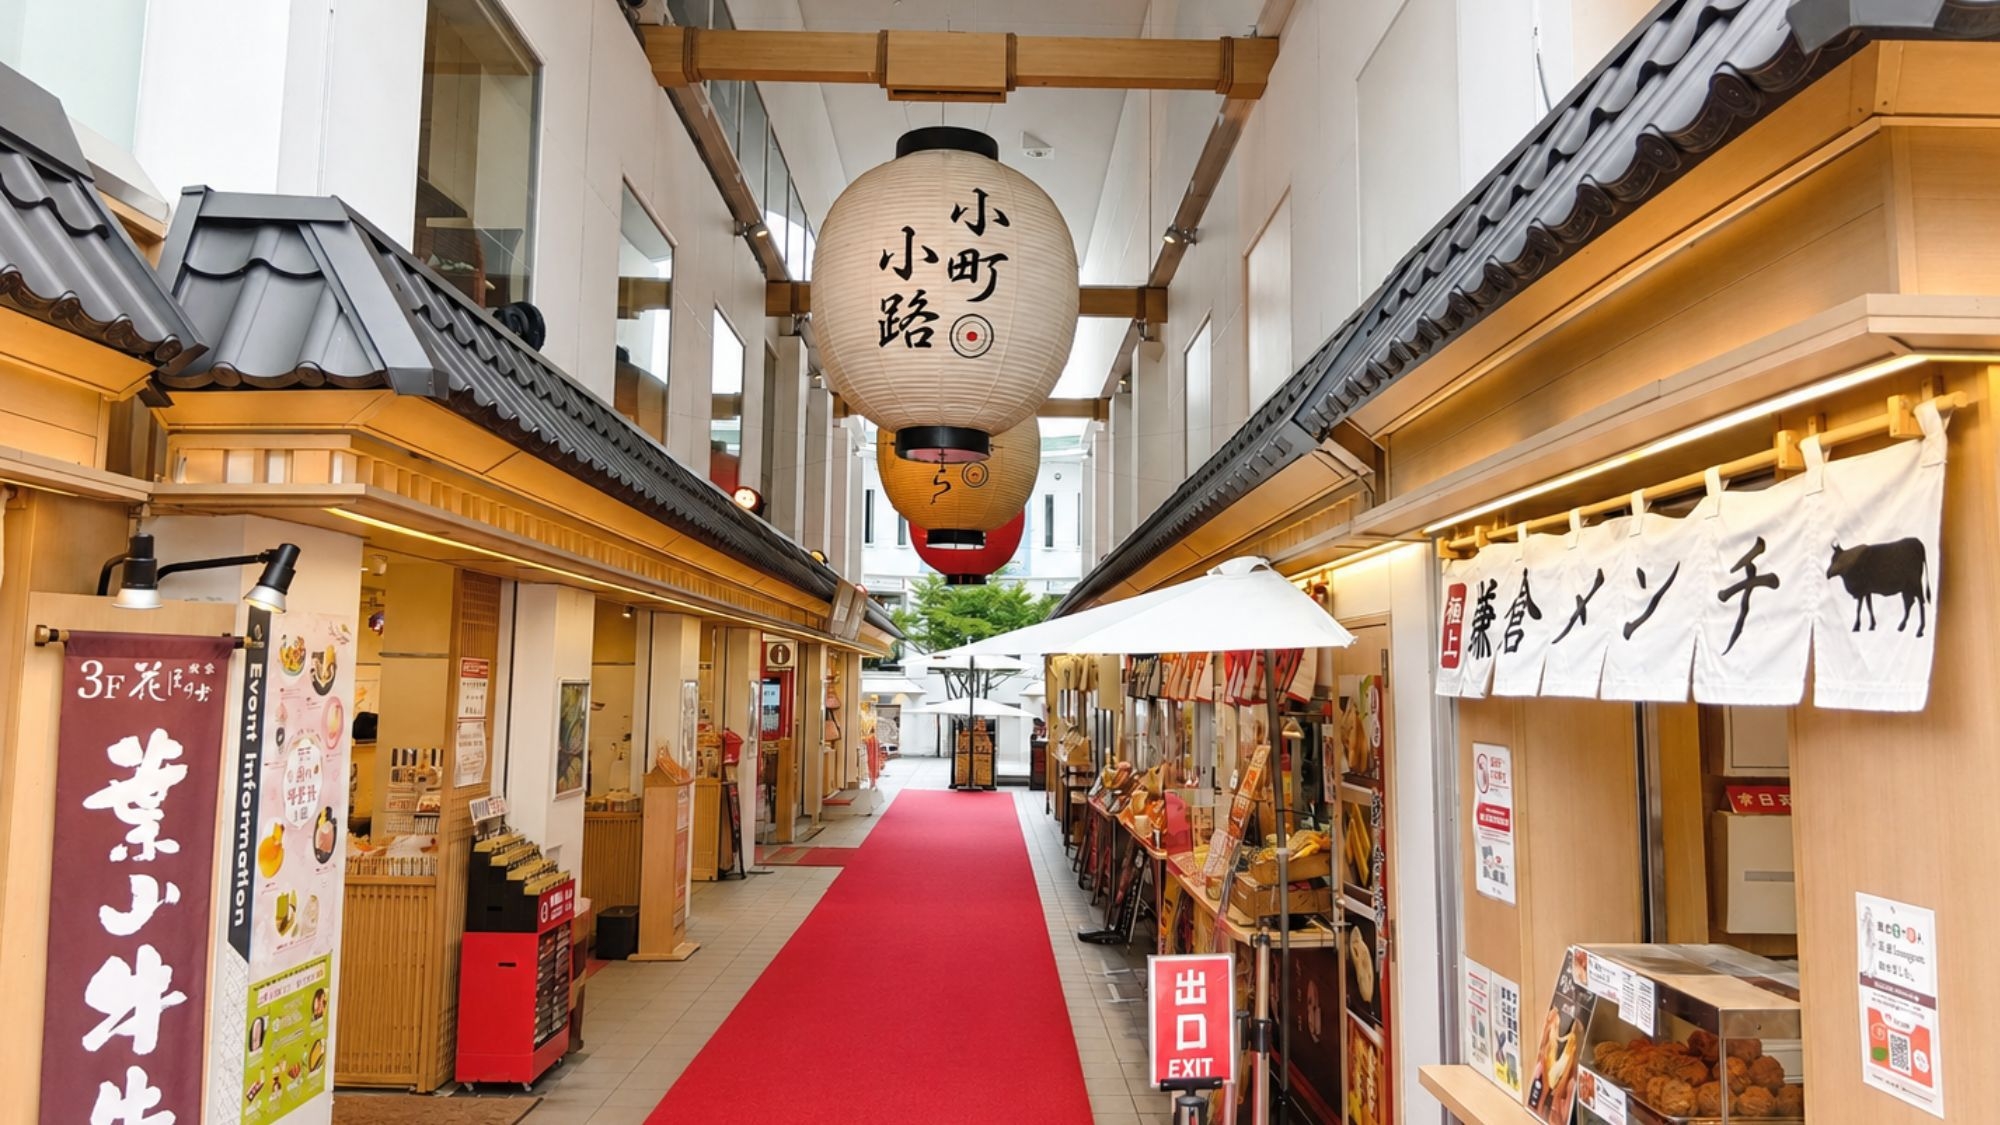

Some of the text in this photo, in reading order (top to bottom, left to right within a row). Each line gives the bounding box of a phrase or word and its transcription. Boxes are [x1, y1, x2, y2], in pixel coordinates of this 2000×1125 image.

[948, 187, 1010, 302] 小町
[878, 225, 939, 349] 小路
[77, 659, 125, 699] 3F
[1175, 968, 1207, 1051] 出口
[1168, 1057, 1213, 1078] EXIT
